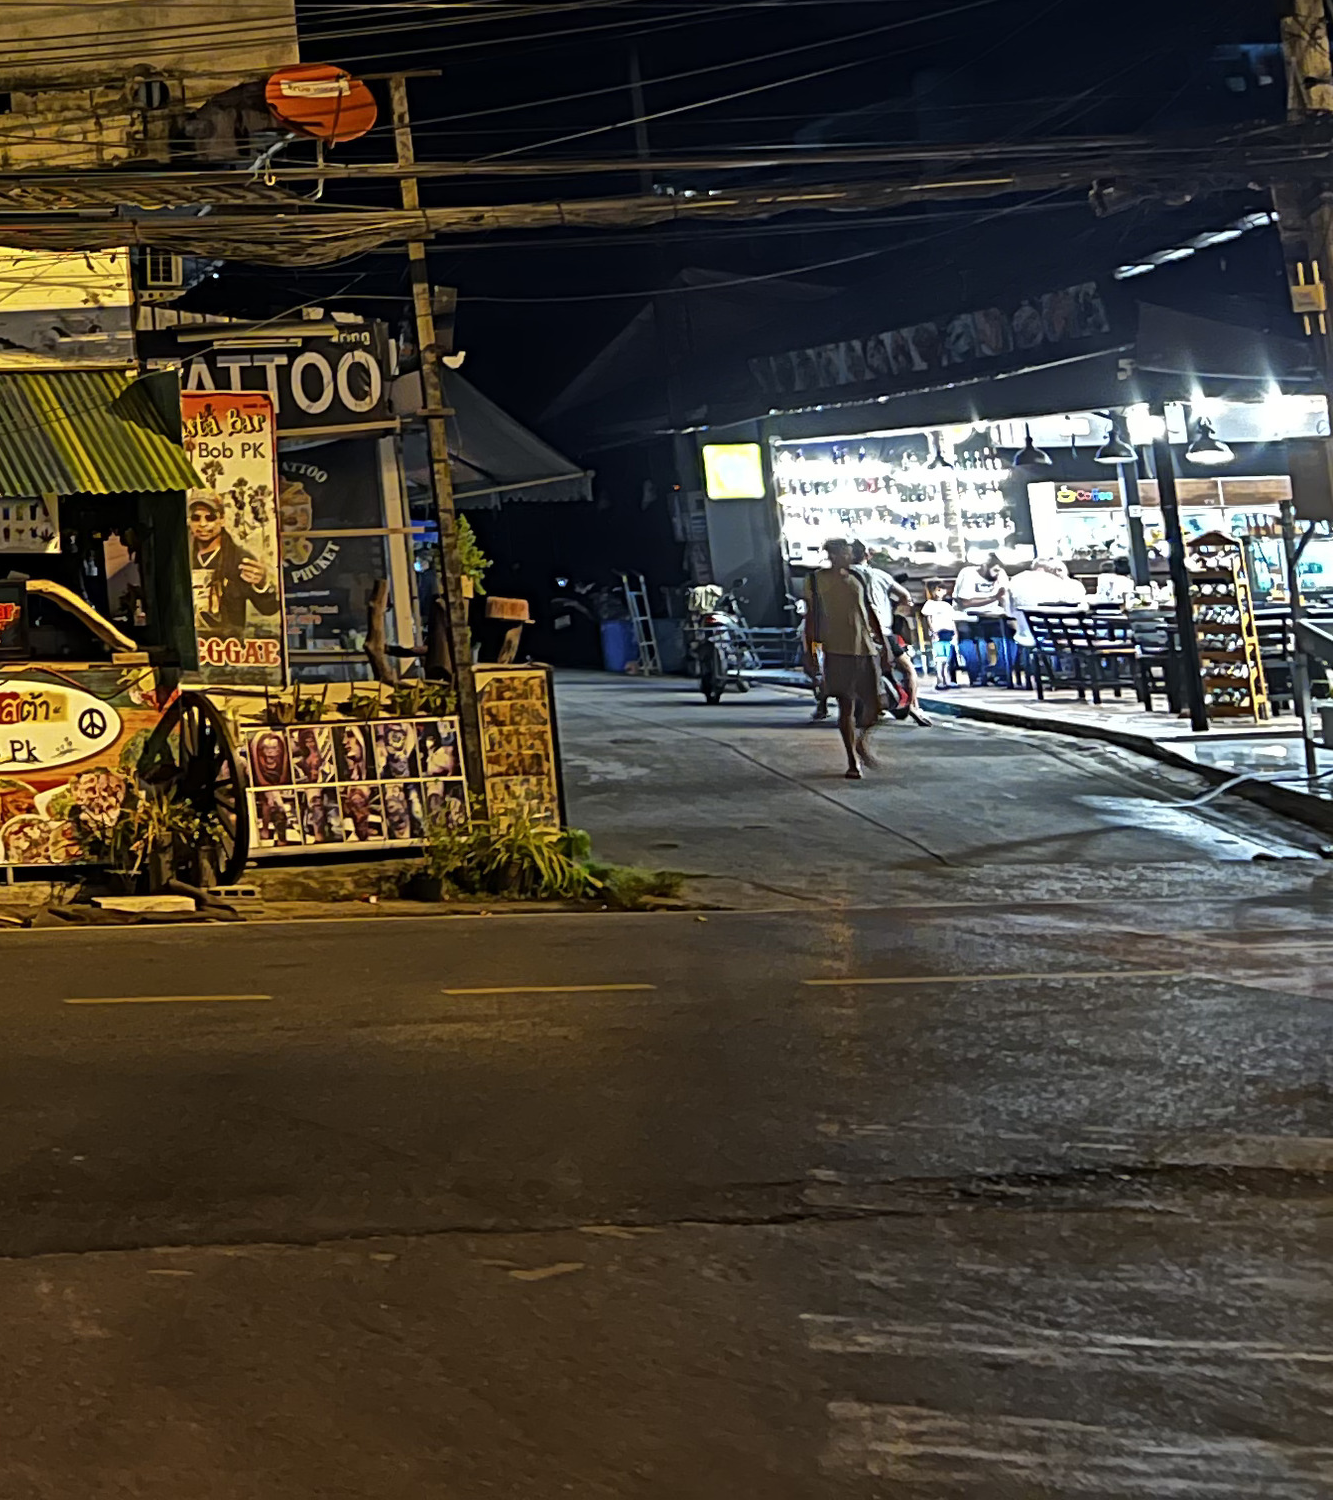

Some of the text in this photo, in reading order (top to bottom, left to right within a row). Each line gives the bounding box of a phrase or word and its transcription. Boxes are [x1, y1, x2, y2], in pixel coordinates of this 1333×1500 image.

[147, 350, 382, 414] ATTOO
[226, 407, 267, 437] Bar
[198, 441, 266, 459] Bob PK
[282, 461, 328, 483] ATTOO
[291, 540, 340, 584] PHUKET
[9, 739, 41, 762] Pk
